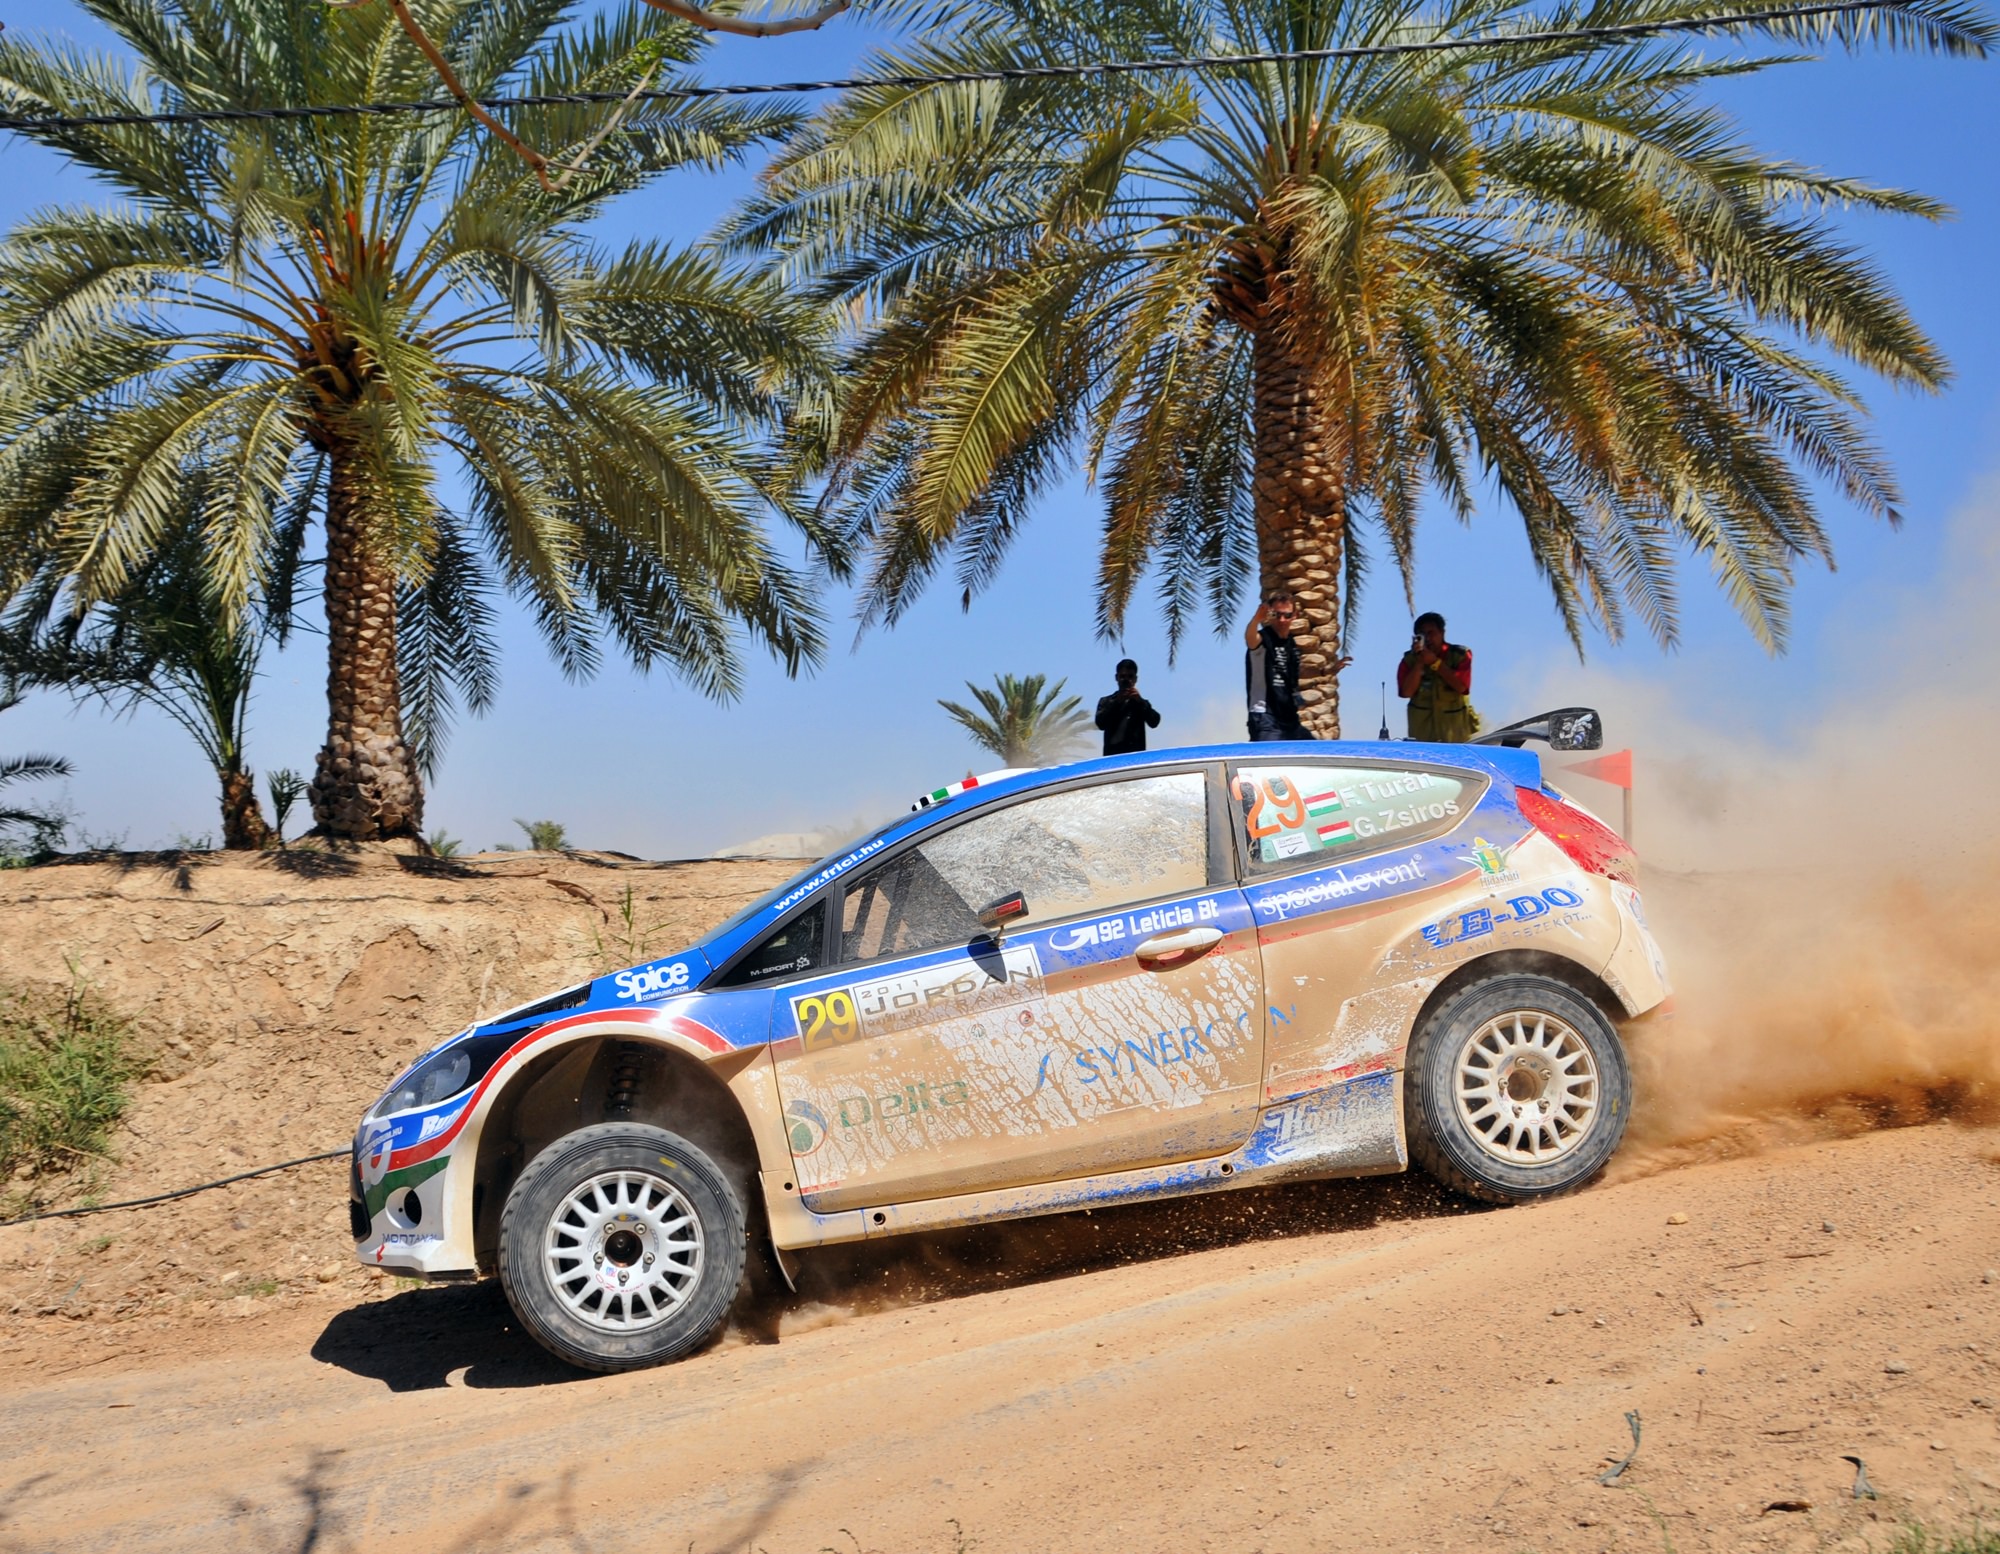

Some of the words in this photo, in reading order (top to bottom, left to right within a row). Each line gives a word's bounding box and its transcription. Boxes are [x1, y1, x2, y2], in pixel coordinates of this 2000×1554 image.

[1231, 774, 1306, 840] 29
[1098, 918, 1126, 943] 92
[1130, 906, 1194, 935] Leticia
[1197, 899, 1220, 920] Bt
[615, 962, 690, 1002] Spice
[750, 962, 795, 977] M-SPORT
[861, 979, 920, 999] 2011
[642, 985, 689, 1001] COMMUNICATION
[864, 966, 1034, 1016] JORDAN
[798, 991, 859, 1052] 29
